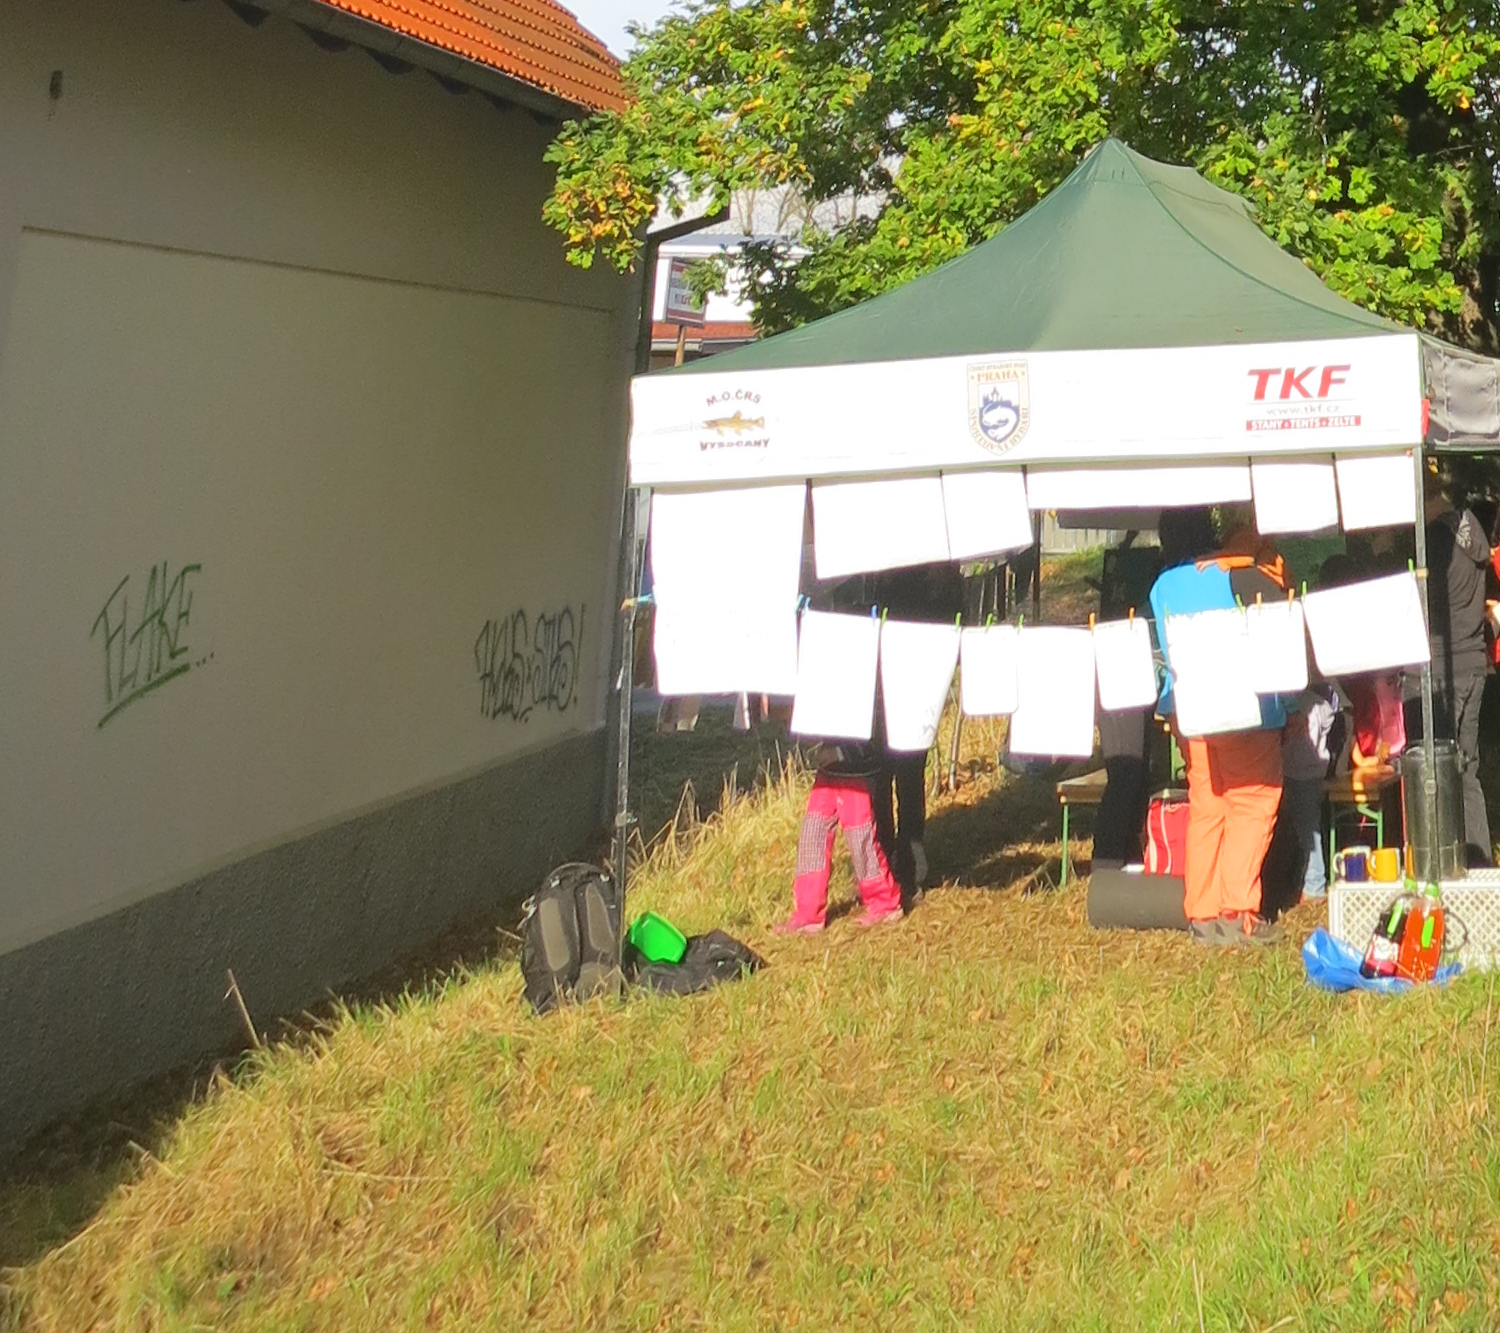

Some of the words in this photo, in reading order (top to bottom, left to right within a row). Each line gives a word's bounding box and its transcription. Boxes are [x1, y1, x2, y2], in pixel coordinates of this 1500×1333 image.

[977, 370, 1019, 382] PRAHA
[1247, 364, 1352, 401] TKF
[1266, 404, 1342, 416] www.tkf.cz
[1251, 419, 1283, 431] STANY
[1289, 417, 1320, 429] TENTS
[1328, 415, 1356, 428] ZELTE
